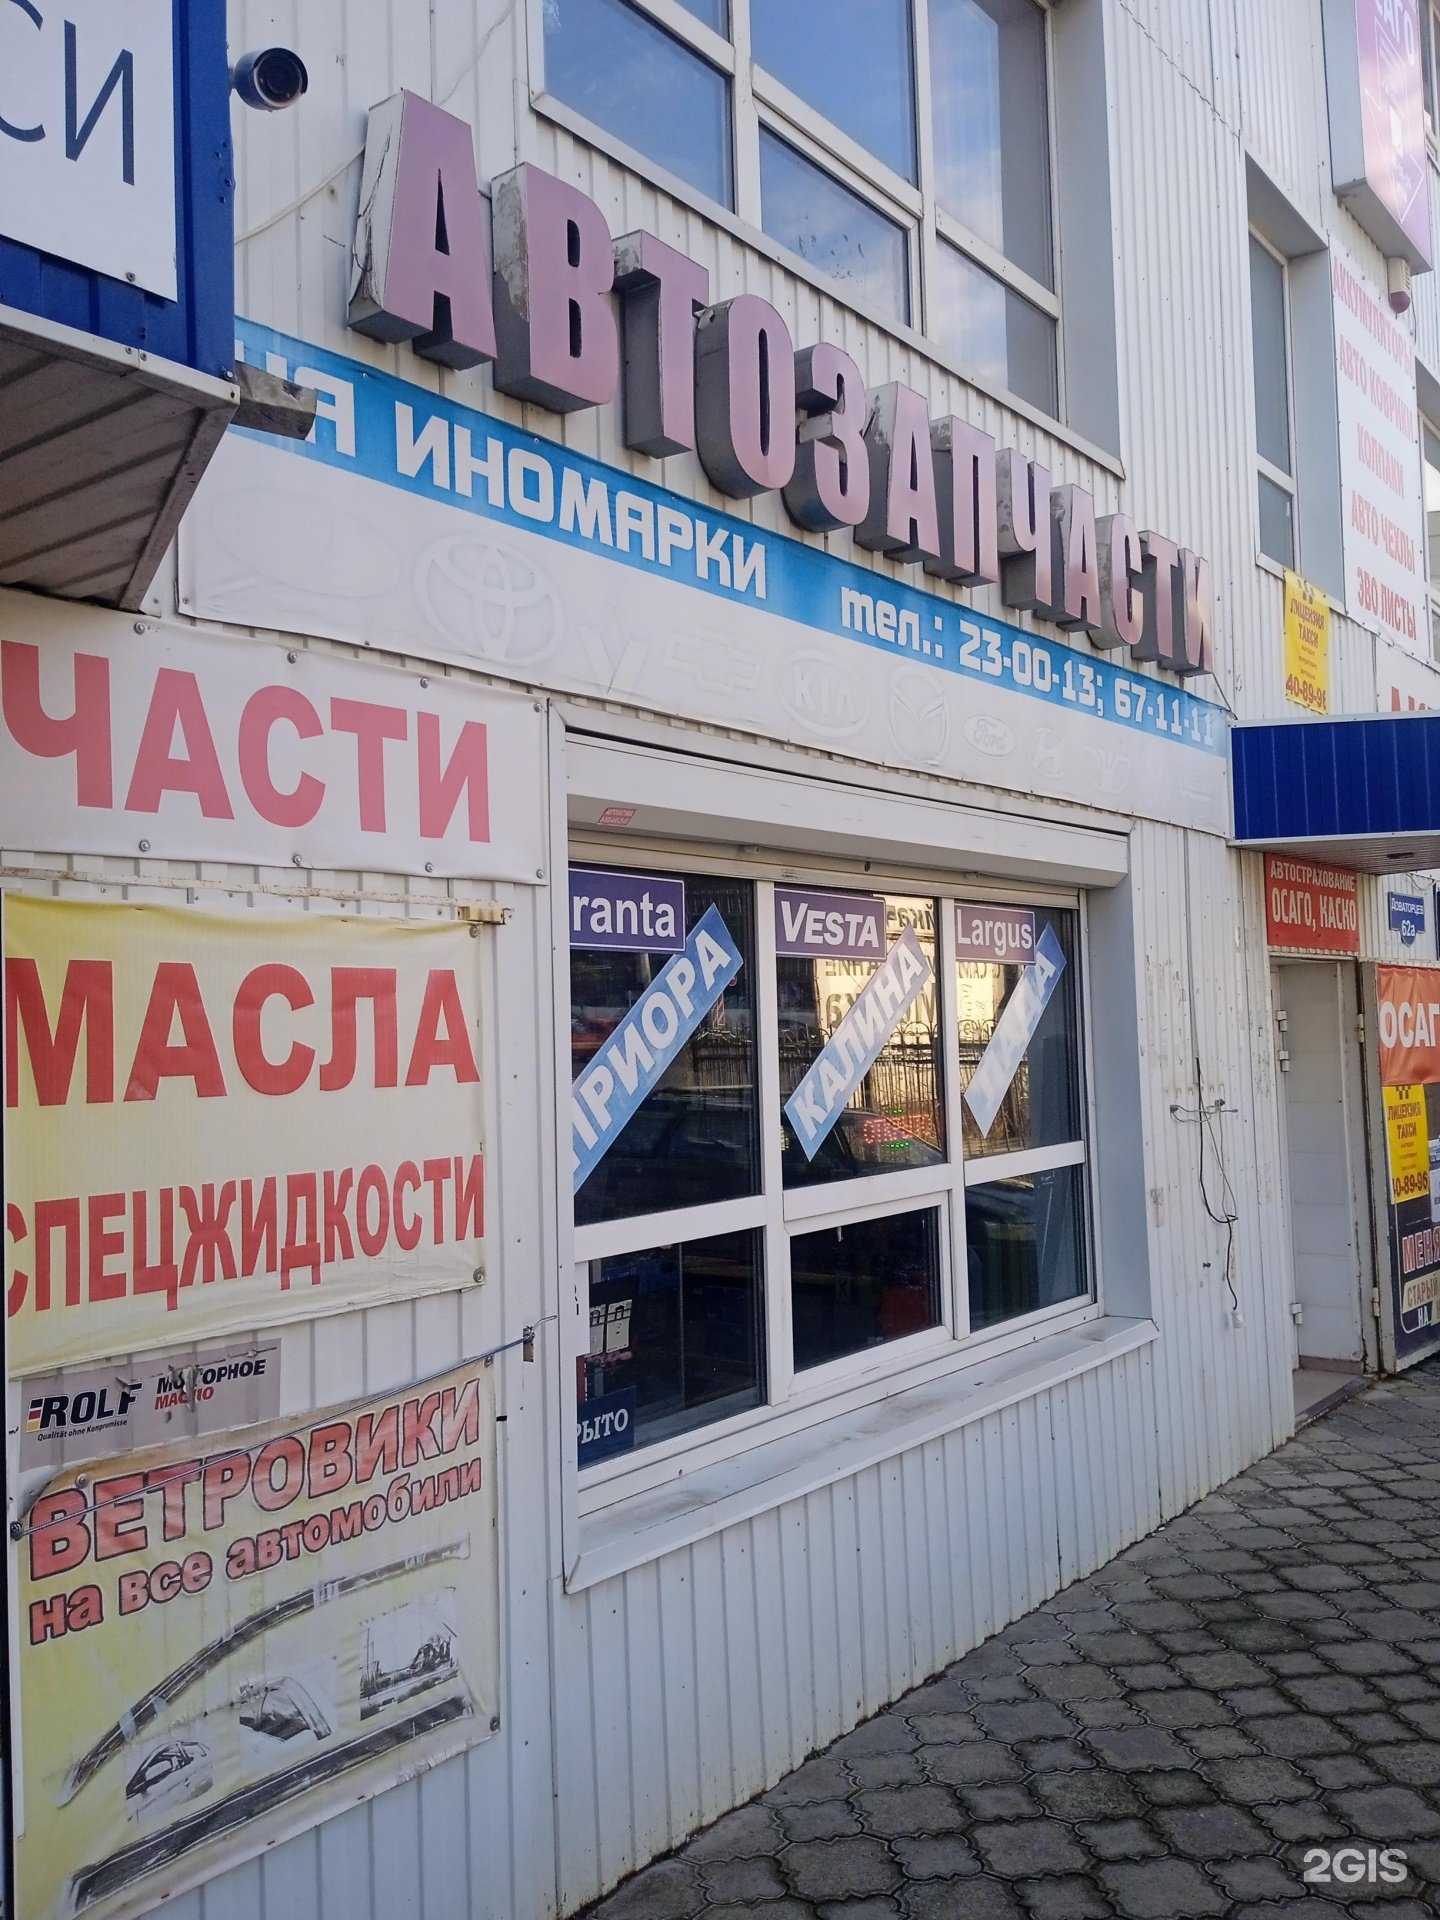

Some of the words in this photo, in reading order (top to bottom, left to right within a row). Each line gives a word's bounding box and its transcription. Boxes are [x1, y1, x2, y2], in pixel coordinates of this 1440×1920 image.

[358, 88, 1213, 676] АВТОЗАПЧАСТИ
[1340, 333, 1367, 395] АВТО
[235, 340, 355, 457] А
[395, 400, 766, 600] ИНОМАРКИ
[840, 584, 943, 658] тел.:
[958, 619, 1104, 717] 23-00-13;
[1114, 678, 1214, 748] 67-11-11
[1352, 490, 1379, 545] АВТО
[1380, 513, 1415, 575] ЧЕХЛЫ
[1298, 622, 1319, 648] ТАКСИ
[1380, 583, 1416, 640] ЛИСТЫ
[3, 640, 491, 843] ЧАСТИ
[1271, 860, 1355, 892] АВТОСТРАХОВАНИЕ
[573, 891, 676, 938] ranta
[781, 901, 880, 949] VESTA
[957, 909, 1032, 955] Largus
[1272, 888, 1316, 932] ОСАГО,
[1320, 894, 1357, 931] КАСКО
[5, 956, 481, 1107] МАСЛА
[794, 942, 925, 1140] КАЛИНА
[1397, 1122, 1417, 1140] ТАКСИ
[157, 1359, 267, 1394] МООРНОЕ
[40, 1383, 142, 1429] ROLF
[37, 1430, 68, 1442] Qualität
[68, 1427, 85, 1438] ohne
[29, 1377, 480, 1581] ВЕТРОВИКИ
[29, 1584, 103, 1646] на
[118, 1553, 213, 1615] все
[226, 1457, 482, 1582] автомобили
